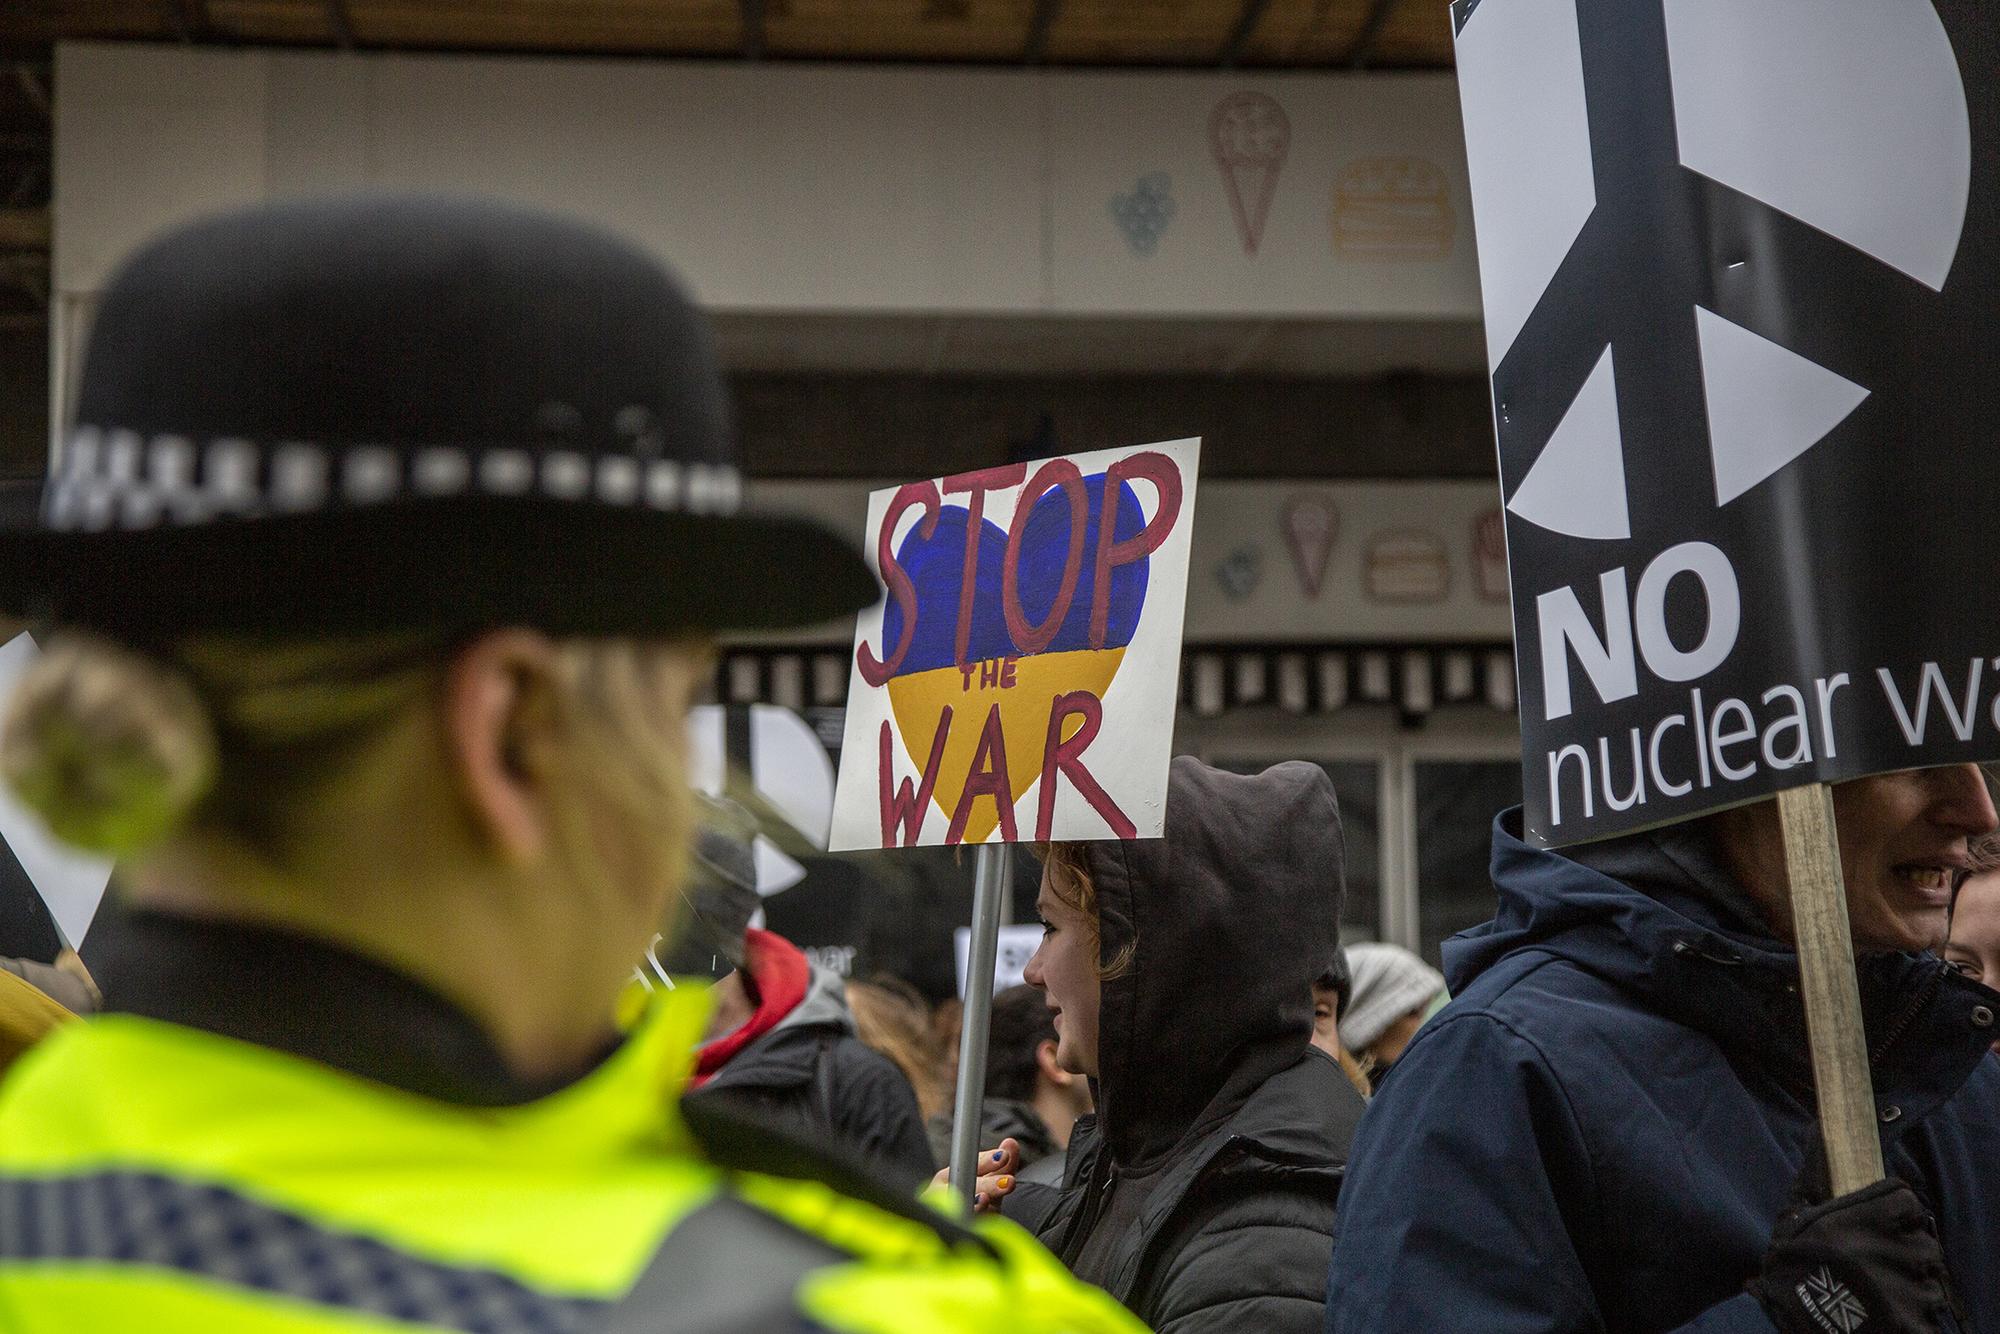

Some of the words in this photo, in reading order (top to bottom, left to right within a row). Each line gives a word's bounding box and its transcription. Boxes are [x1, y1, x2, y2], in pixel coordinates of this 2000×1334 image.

[857, 451, 1183, 688] STOP
[1536, 541, 1740, 721] NO
[958, 654, 1019, 692] THE
[1547, 671, 1850, 826] nuclear
[879, 690, 1138, 849] WAR
